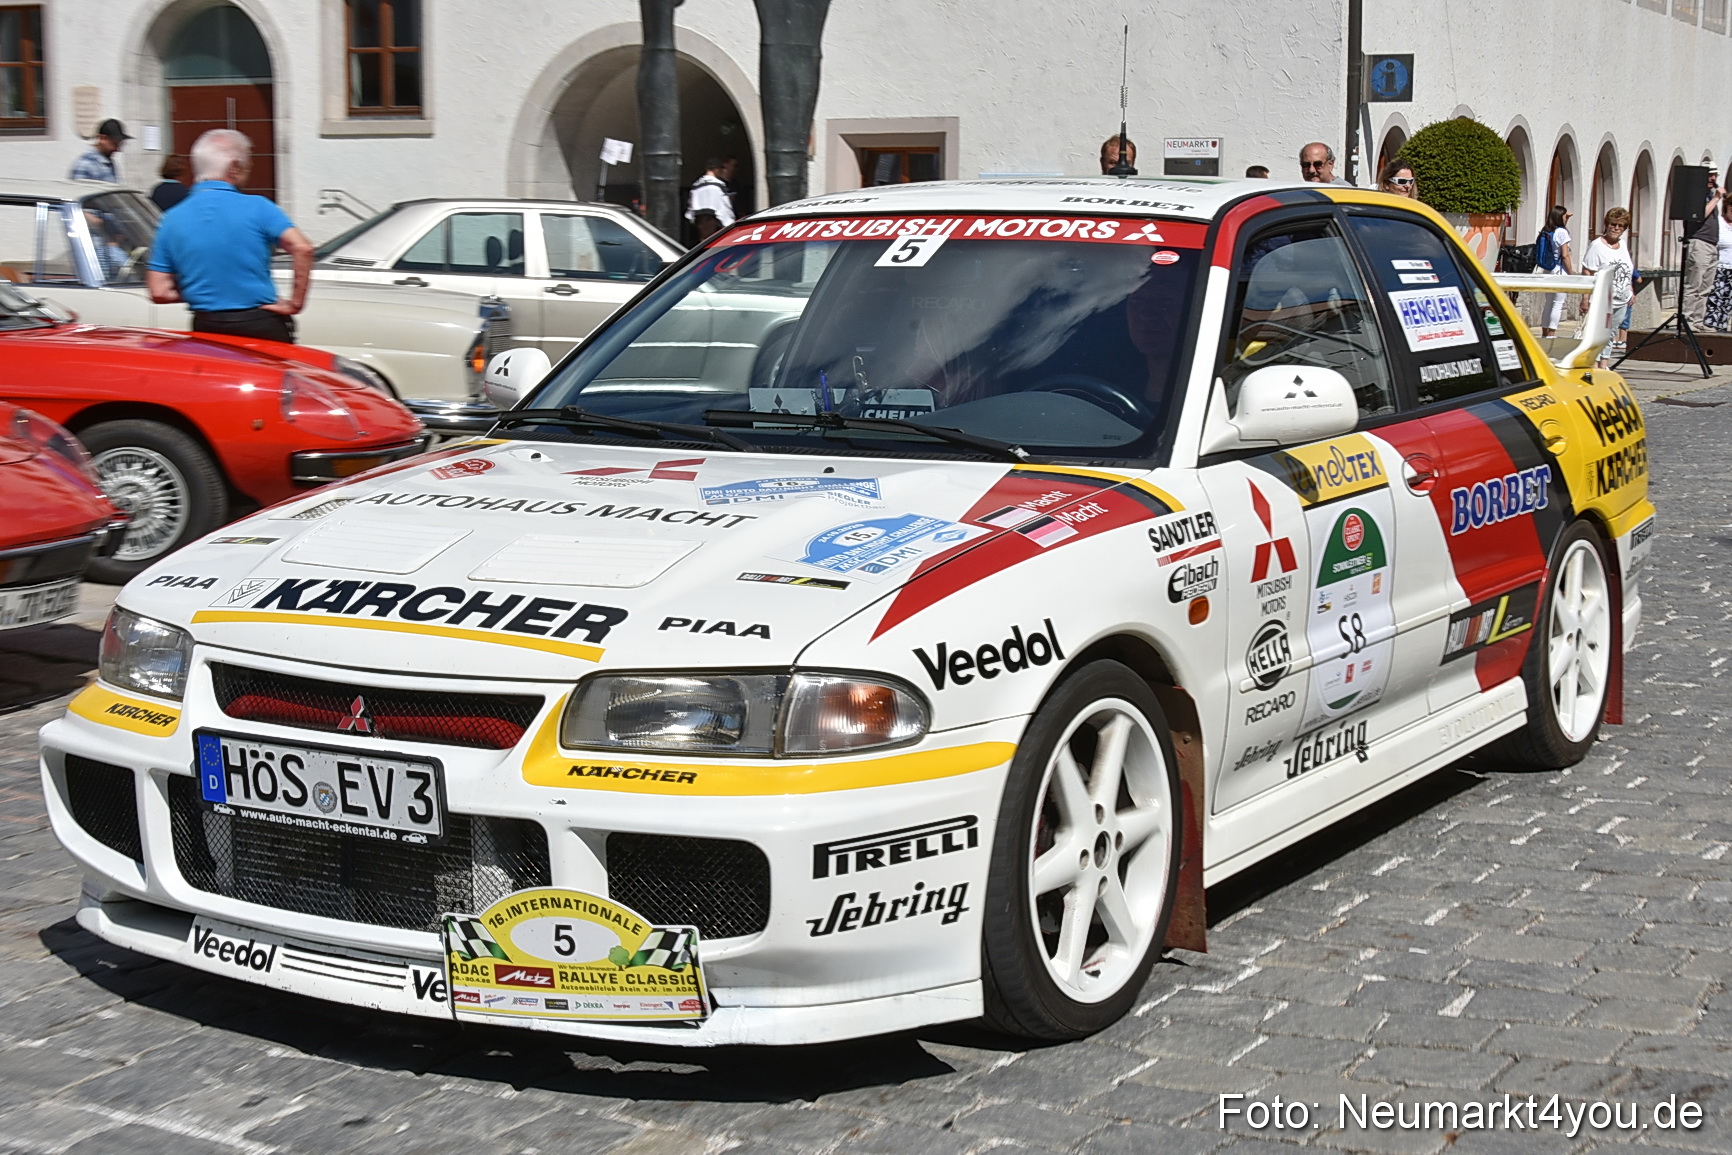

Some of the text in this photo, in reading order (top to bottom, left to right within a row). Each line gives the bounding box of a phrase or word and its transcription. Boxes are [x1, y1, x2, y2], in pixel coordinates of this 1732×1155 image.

[1059, 196, 1195, 212] BORBET
[769, 217, 1121, 239] MITSUBISHI MOTORS
[891, 238, 928, 263] 5
[1398, 295, 1463, 328] HENGLEIN
[1420, 360, 1460, 383] AUTOHAUS
[359, 492, 760, 529] AUTOHAUS MACHT
[733, 494, 785, 503] DMI
[1018, 490, 1072, 510] Macht
[1451, 465, 1551, 536] BORBET
[1055, 501, 1109, 526] Macht
[1147, 511, 1218, 552] SANDTLER
[878, 546, 923, 566] DMI
[145, 575, 217, 589] PIAA
[1168, 554, 1219, 604] Eibach
[253, 578, 630, 645] KÄRCHER
[658, 616, 772, 640] PIAA
[912, 617, 1067, 692] Veedol
[1249, 632, 1292, 674] HELLA
[105, 702, 177, 728] KÄRCHER
[1244, 690, 1297, 726] RECARO
[1284, 720, 1370, 780] Sebring
[209, 774, 219, 790] D
[567, 764, 698, 784] KÄRCHER
[337, 761, 395, 820] EV
[405, 770, 435, 825] 3
[812, 814, 979, 880] PIRELLI
[806, 881, 970, 938] Sebring
[192, 924, 277, 974] Veedol
[553, 924, 576, 957] 5
[451, 962, 552, 986] ADAC Metz
[559, 971, 698, 986] RALLYE CLASSIC
[560, 983, 617, 992] Automobilclub
[619, 985, 640, 993] Stein
